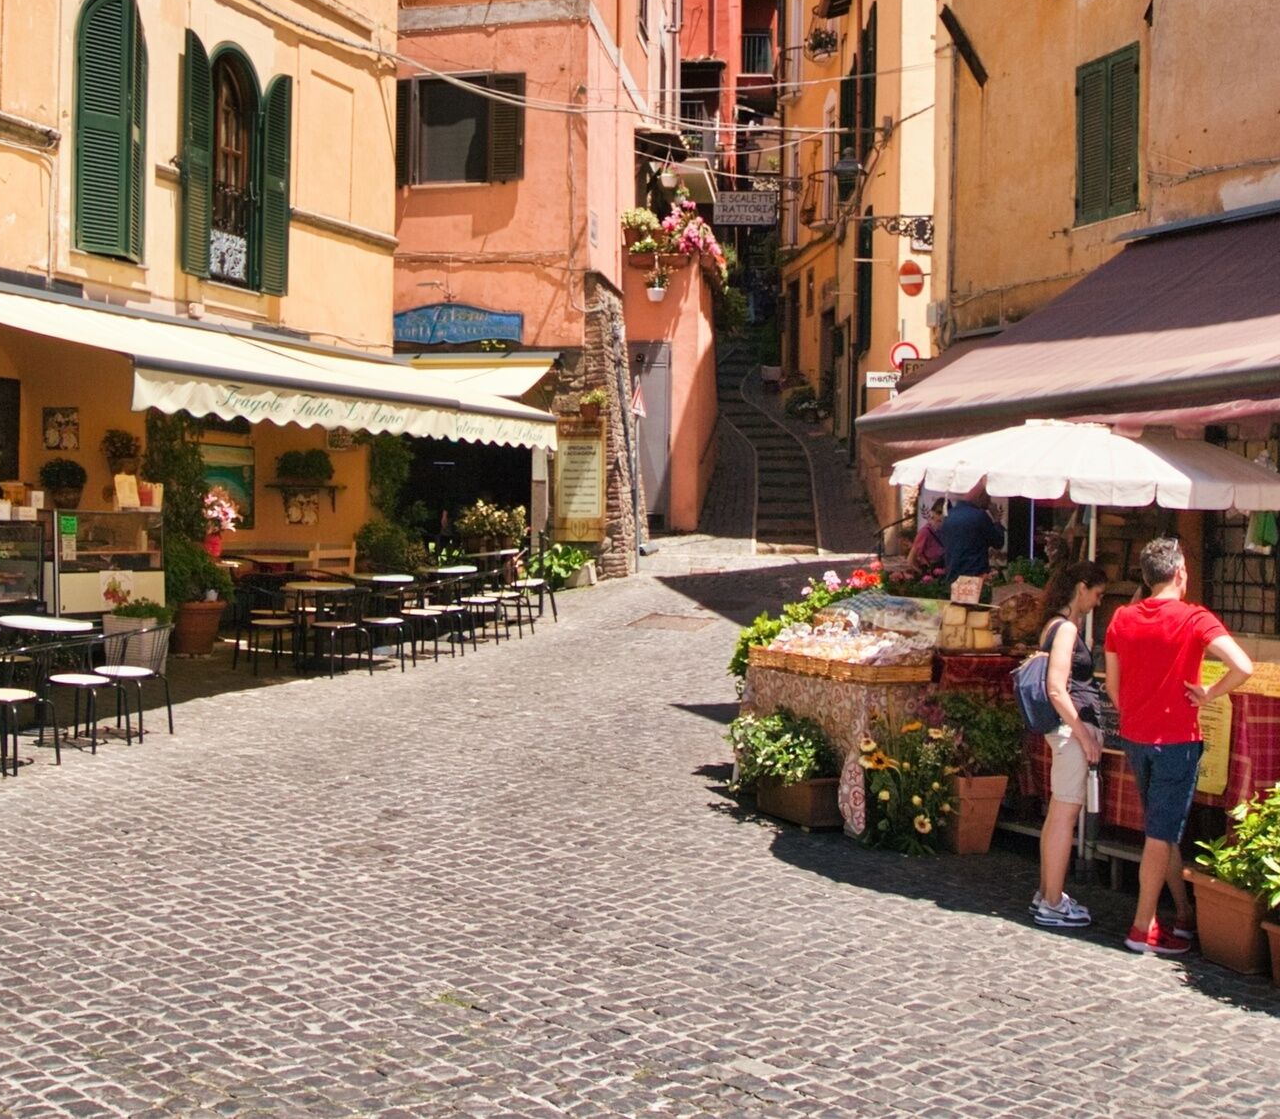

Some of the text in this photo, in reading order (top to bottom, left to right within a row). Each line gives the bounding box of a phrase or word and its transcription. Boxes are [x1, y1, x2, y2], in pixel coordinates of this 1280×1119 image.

[728, 193, 775, 203] SCALETTE
[216, 384, 284, 414] Fragole
[292, 393, 333, 418] Tutto
